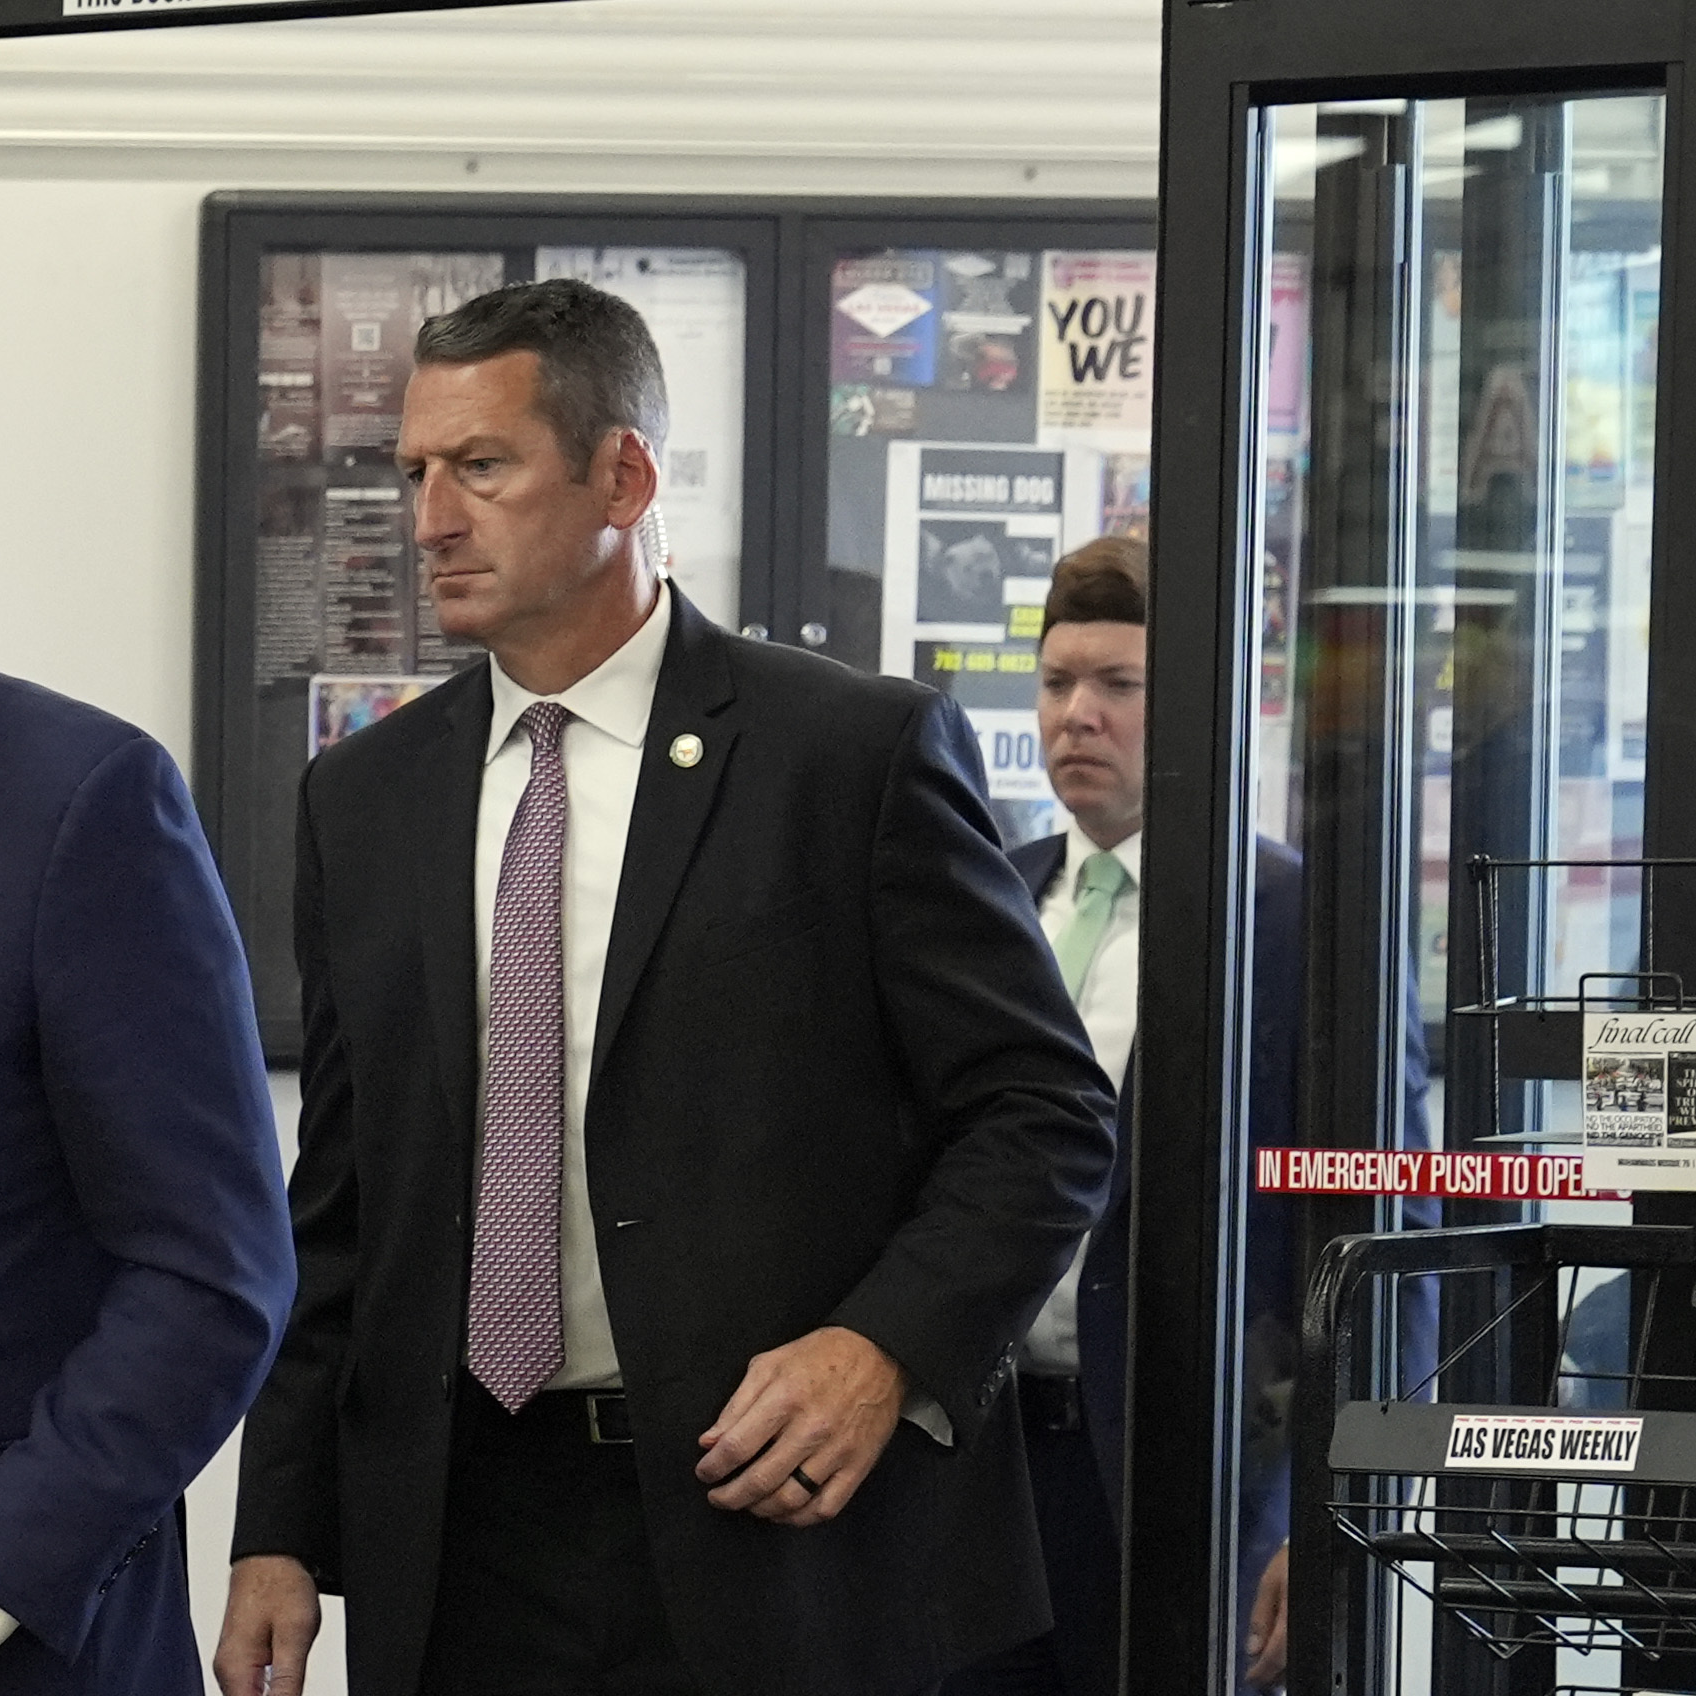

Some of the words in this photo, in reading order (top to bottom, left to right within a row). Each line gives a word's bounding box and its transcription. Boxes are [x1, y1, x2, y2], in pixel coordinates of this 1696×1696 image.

[1048, 294, 1144, 341] YOU
[1069, 335, 1147, 383] WE
[924, 474, 1008, 502] MISSING
[1012, 475, 1054, 504] DOG
[1588, 1018, 1664, 1049] final
[1653, 1019, 1696, 1043] call
[1258, 1149, 1281, 1188] IN
[1288, 1151, 1422, 1192] EMERGENCY
[1430, 1155, 1492, 1195] PUSH
[1498, 1156, 1529, 1195] TO
[1537, 1157, 1597, 1198] OPE
[1450, 1428, 1487, 1458] LAS
[1492, 1428, 1555, 1459] VEGAS
[1559, 1430, 1637, 1461] WEEKLY
